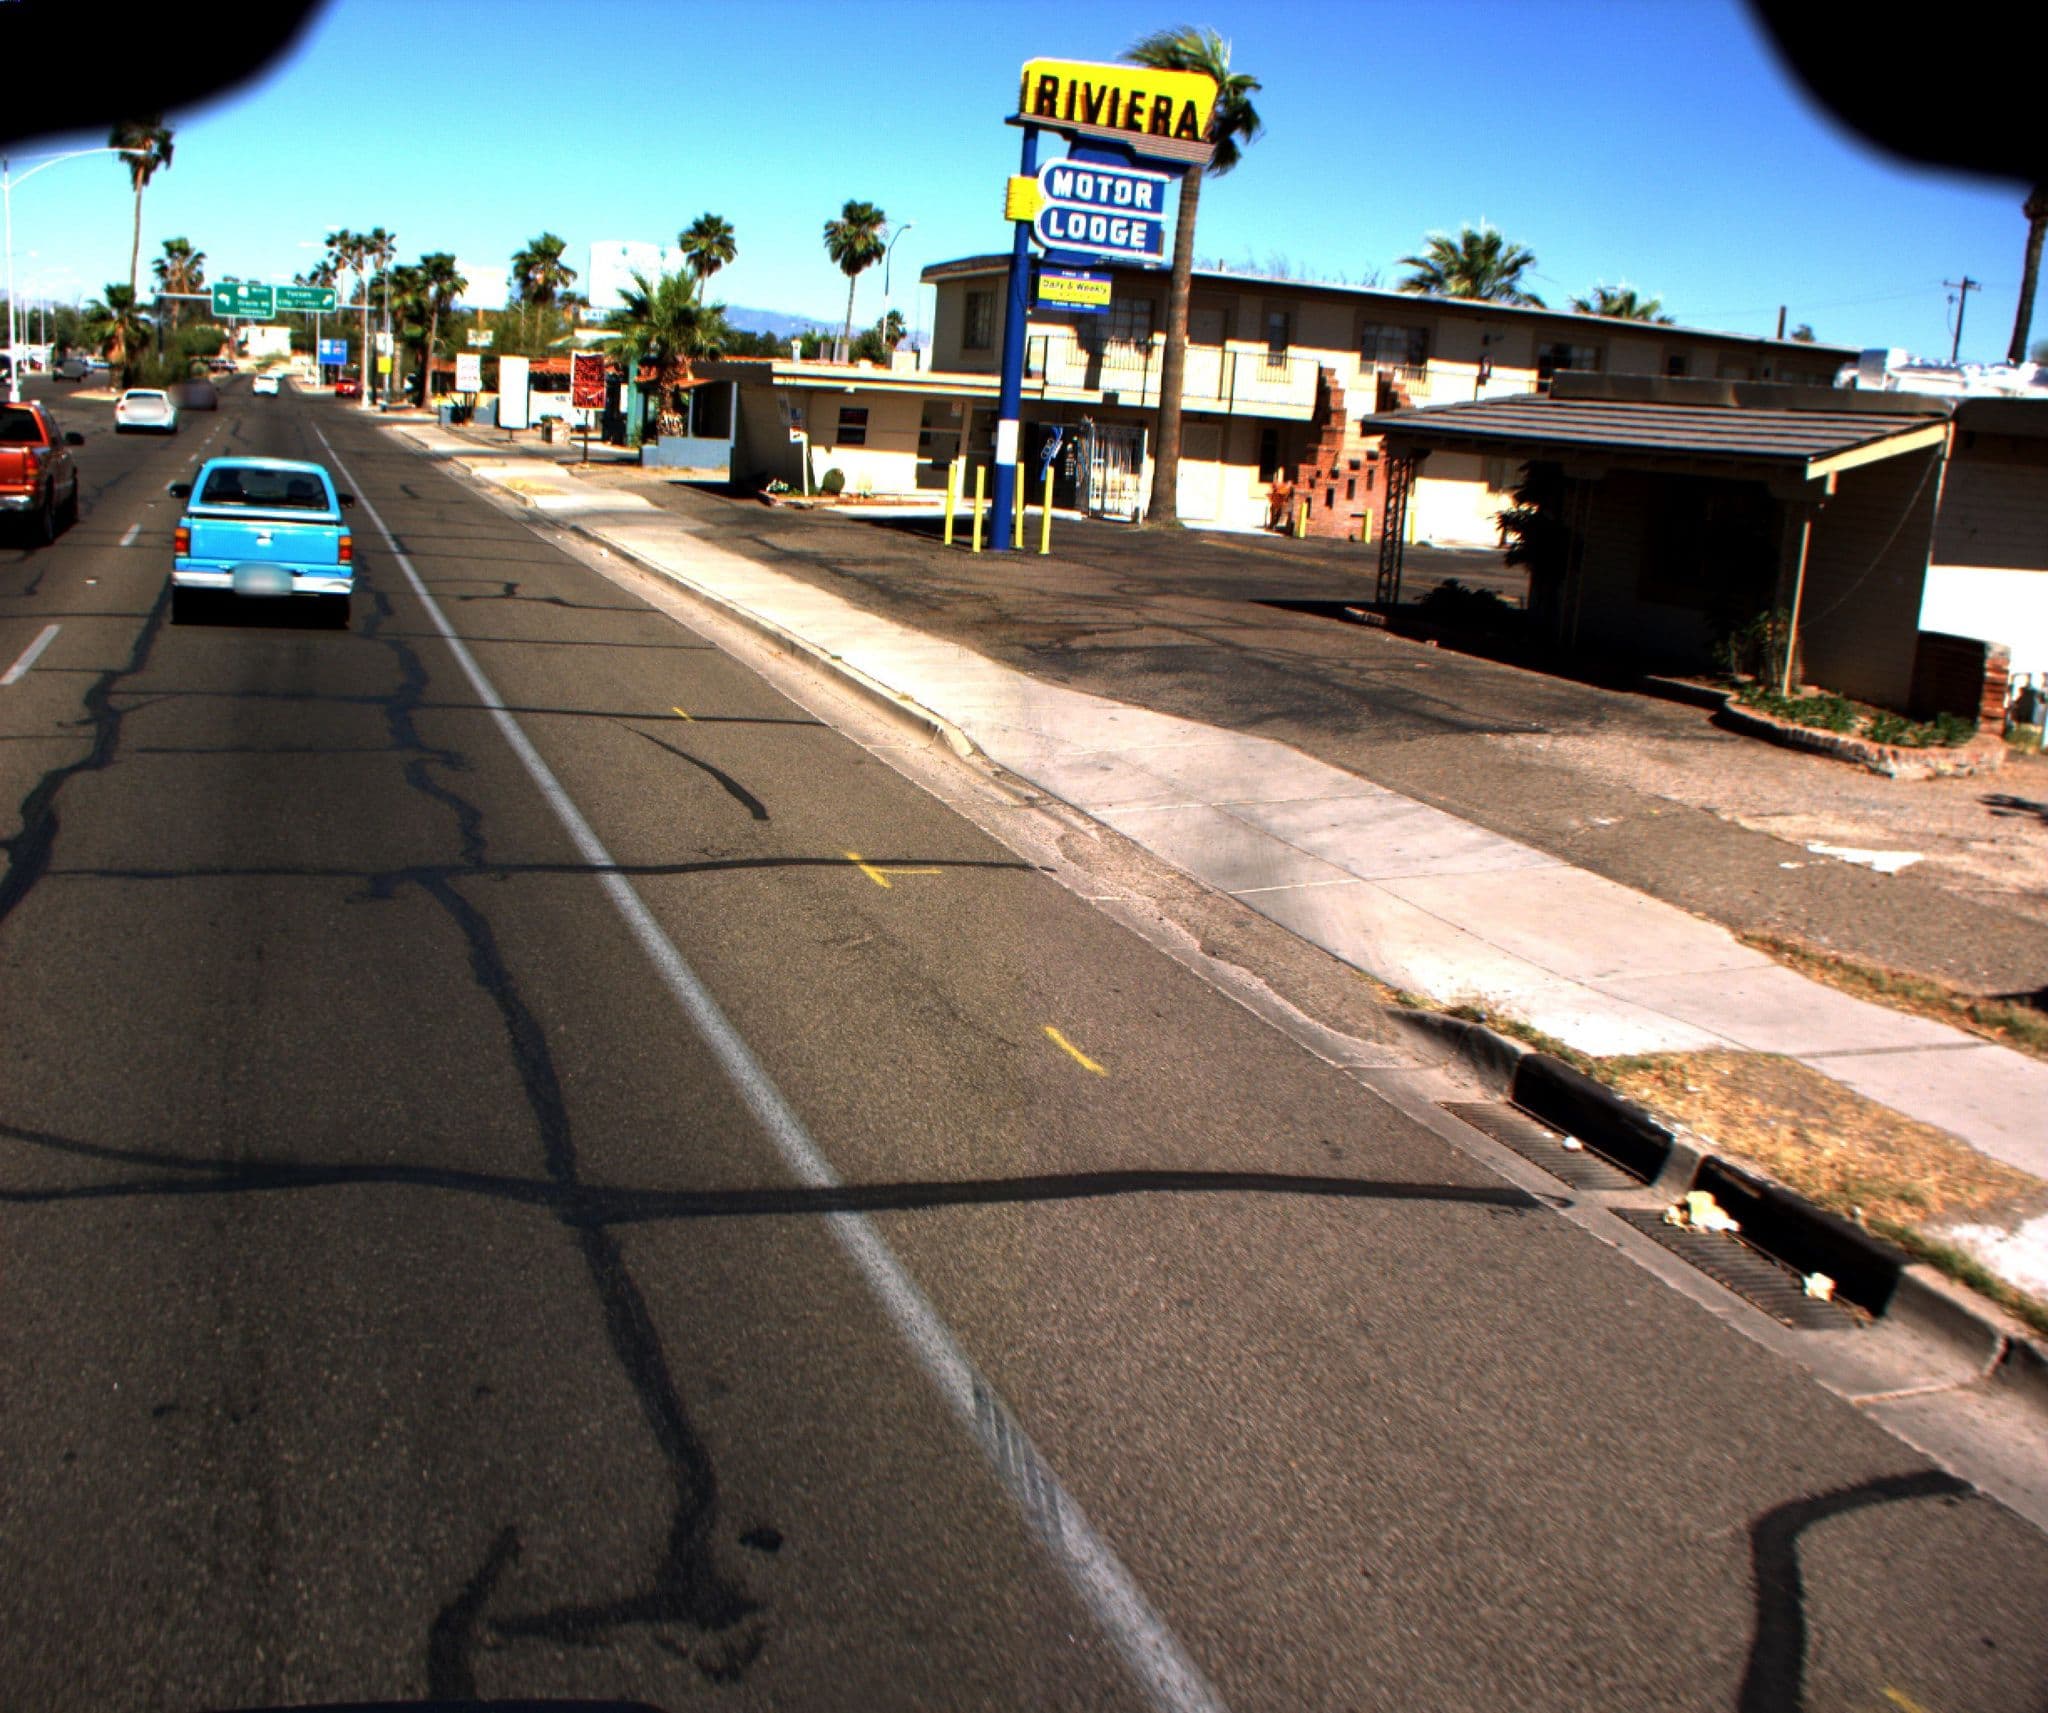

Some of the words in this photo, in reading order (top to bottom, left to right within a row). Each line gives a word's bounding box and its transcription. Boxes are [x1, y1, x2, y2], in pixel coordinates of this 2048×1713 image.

[1035, 74, 1201, 141] RIVIERA
[1053, 169, 1152, 209] MOTOR
[1049, 210, 1148, 248] LODGE
[1043, 279, 1063, 290] Daily
[1067, 281, 1073, 290] &
[1076, 282, 1108, 295] Weekly
